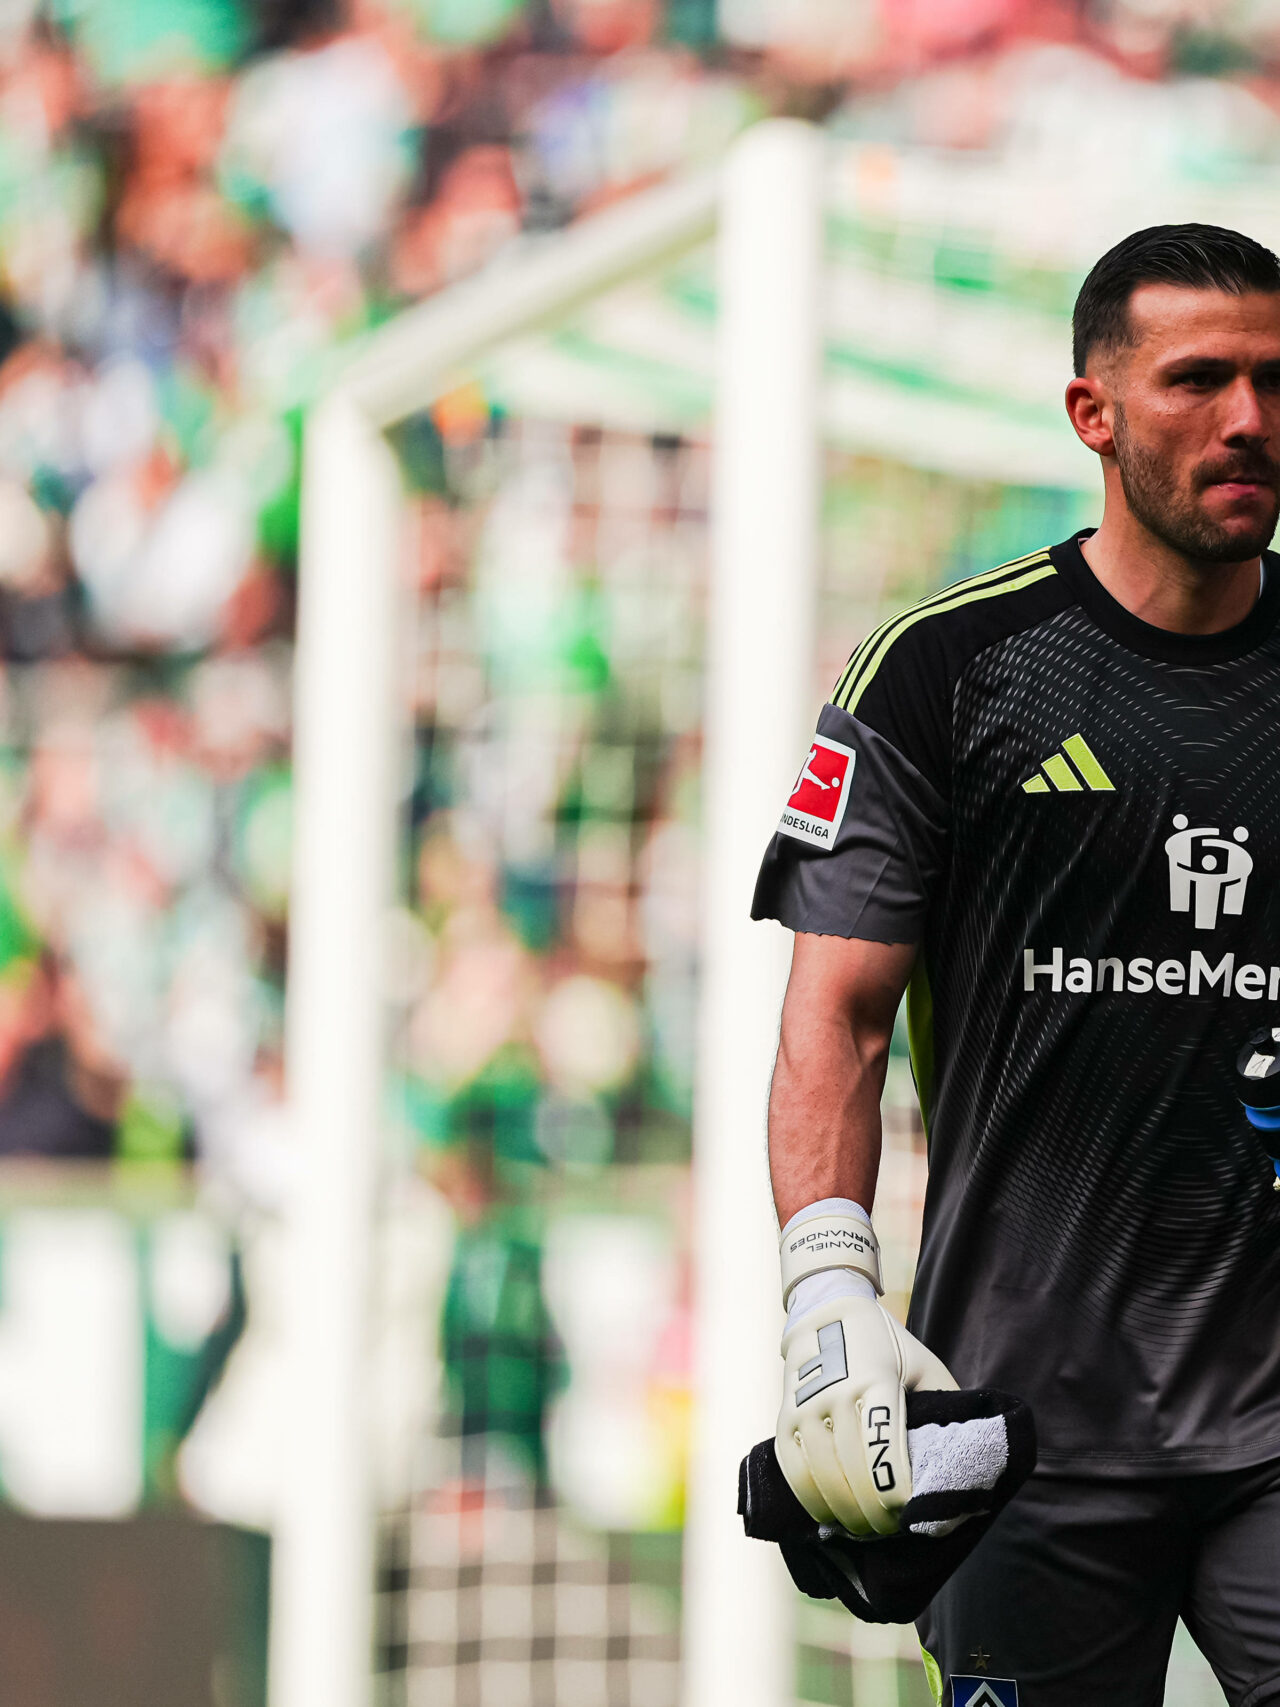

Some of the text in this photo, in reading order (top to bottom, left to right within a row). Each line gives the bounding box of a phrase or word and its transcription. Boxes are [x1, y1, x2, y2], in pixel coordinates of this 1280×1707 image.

[779, 813, 830, 839] NDESLIGA
[789, 1229, 876, 1254] FERNANDES
[806, 1241, 864, 1254] DANIEL
